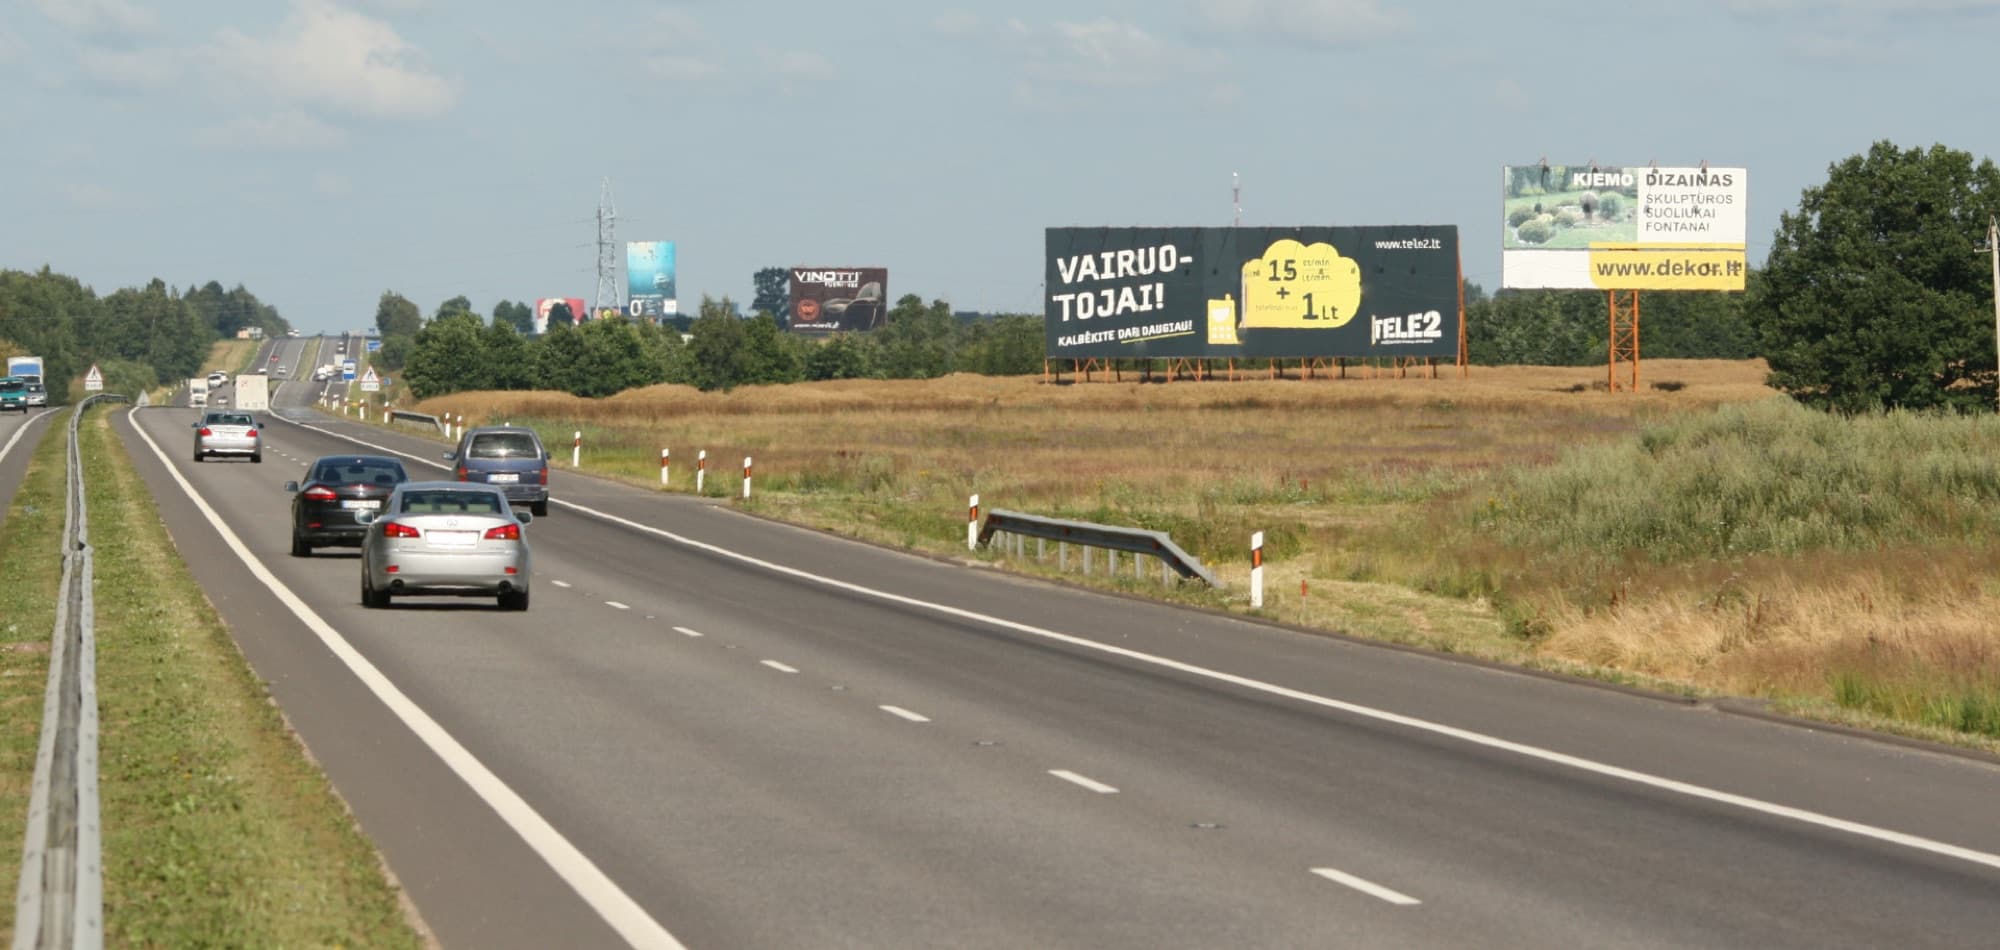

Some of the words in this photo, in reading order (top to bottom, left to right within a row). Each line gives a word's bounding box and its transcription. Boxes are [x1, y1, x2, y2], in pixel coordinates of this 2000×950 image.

[1573, 173, 1633, 187] KIEMO
[1646, 174, 1733, 187] DIZAINAS
[1646, 207, 1716, 218] SUOLIUKAI
[1646, 222, 1710, 232] FONTANAI
[1375, 238, 1441, 249] www.tele2.lt
[1056, 244, 1193, 284] VAIRUO-
[1268, 259, 1297, 281] 15
[1597, 259, 1742, 277] www.dekor.lt
[794, 271, 860, 283] VINOTTI
[1052, 282, 1164, 322] TOJAI!
[1321, 304, 1339, 320] Lt
[1058, 329, 1116, 347] KALBĖKITE
[1118, 327, 1141, 339] DAR
[1142, 320, 1193, 335] DAUGIAU!
[1371, 310, 1442, 340] TELE2
